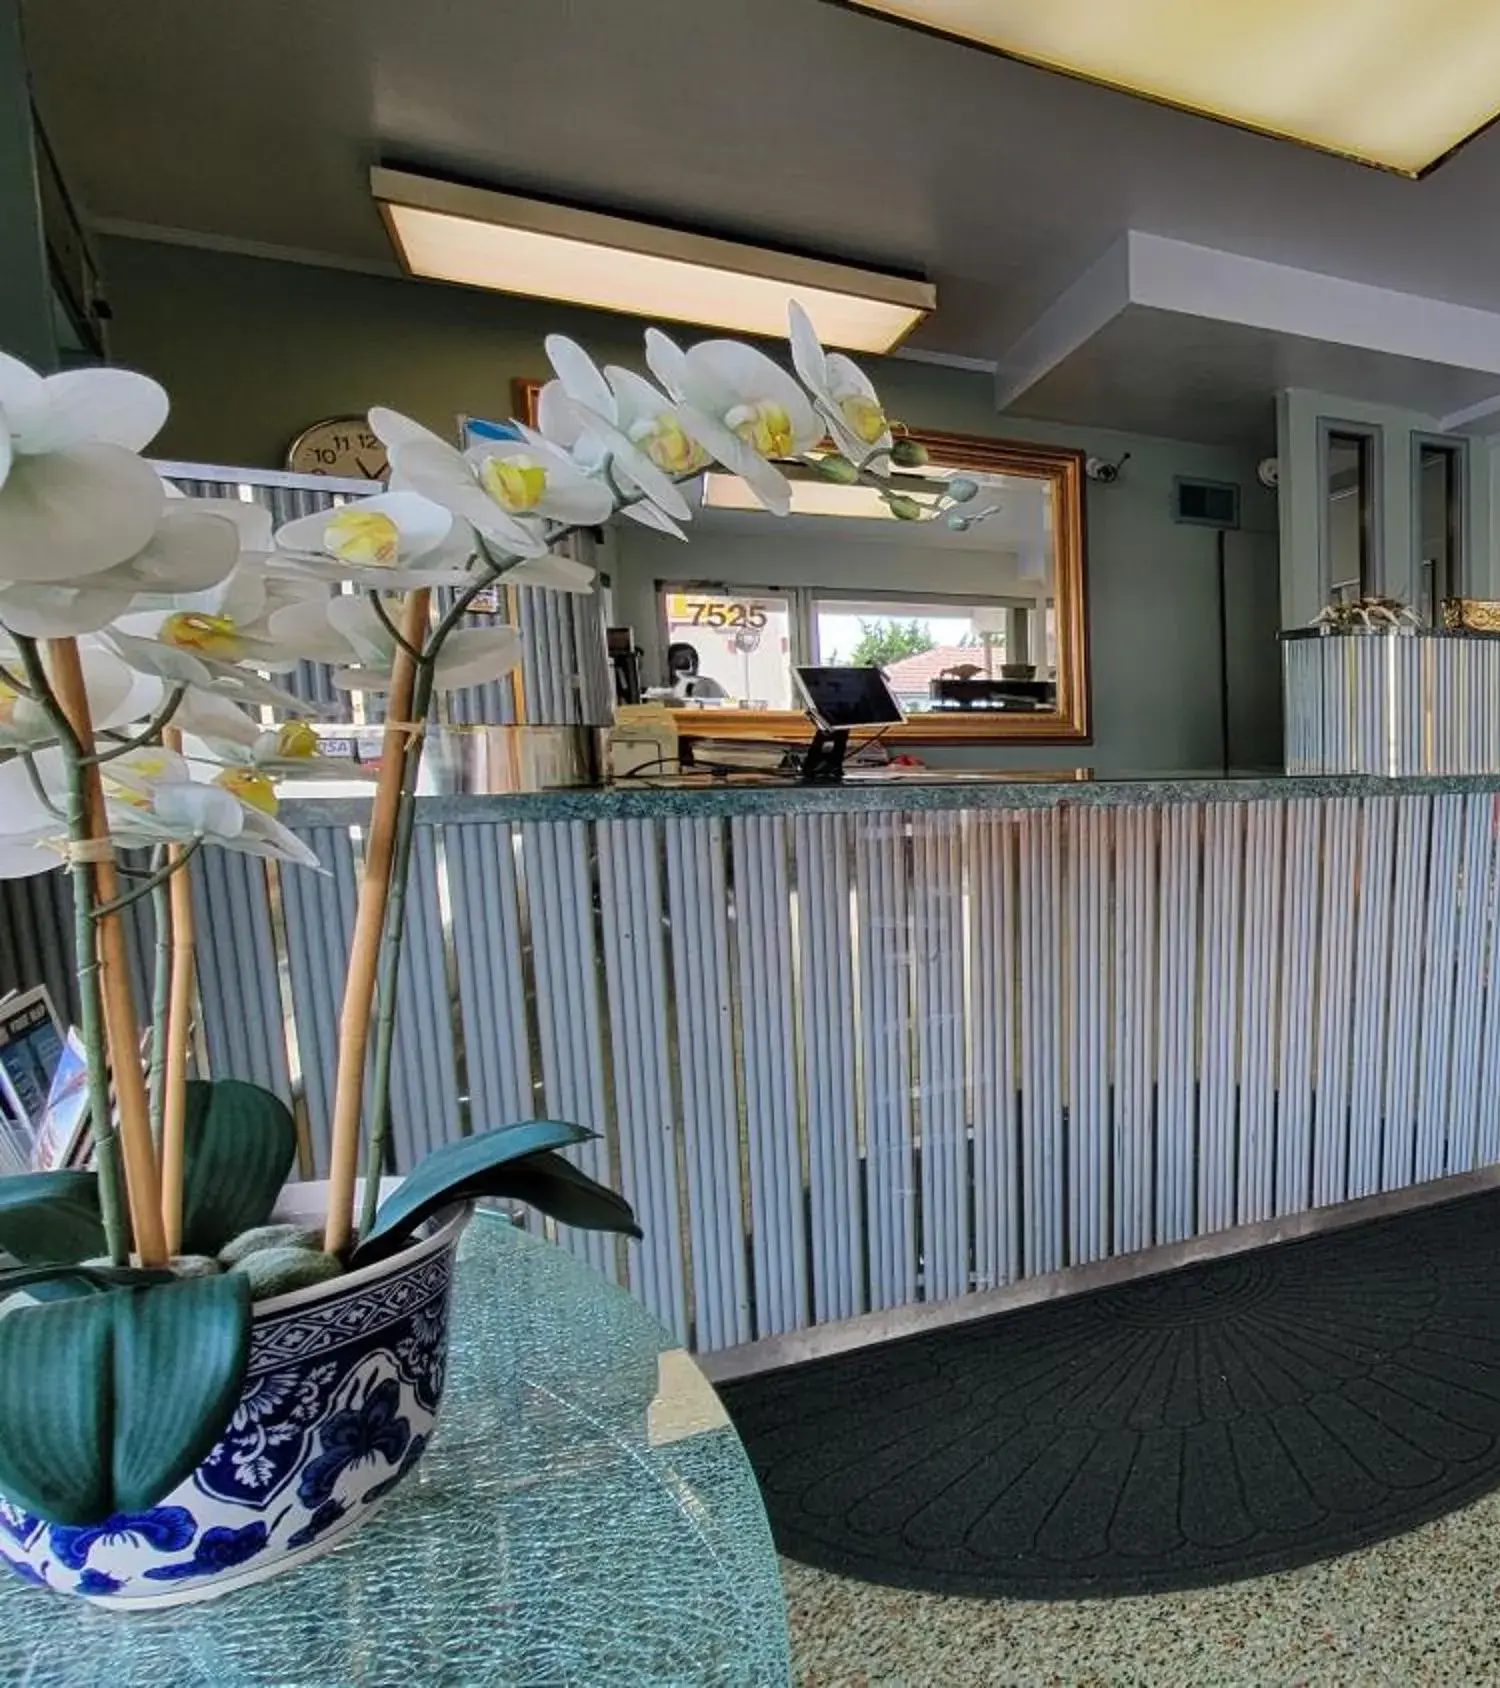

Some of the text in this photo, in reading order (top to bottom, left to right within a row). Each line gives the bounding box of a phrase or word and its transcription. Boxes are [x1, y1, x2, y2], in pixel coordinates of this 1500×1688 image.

[334, 436, 349, 451] 11
[358, 434, 377, 449] 12
[313, 449, 337, 465] 10
[687, 603, 768, 628] 7525
